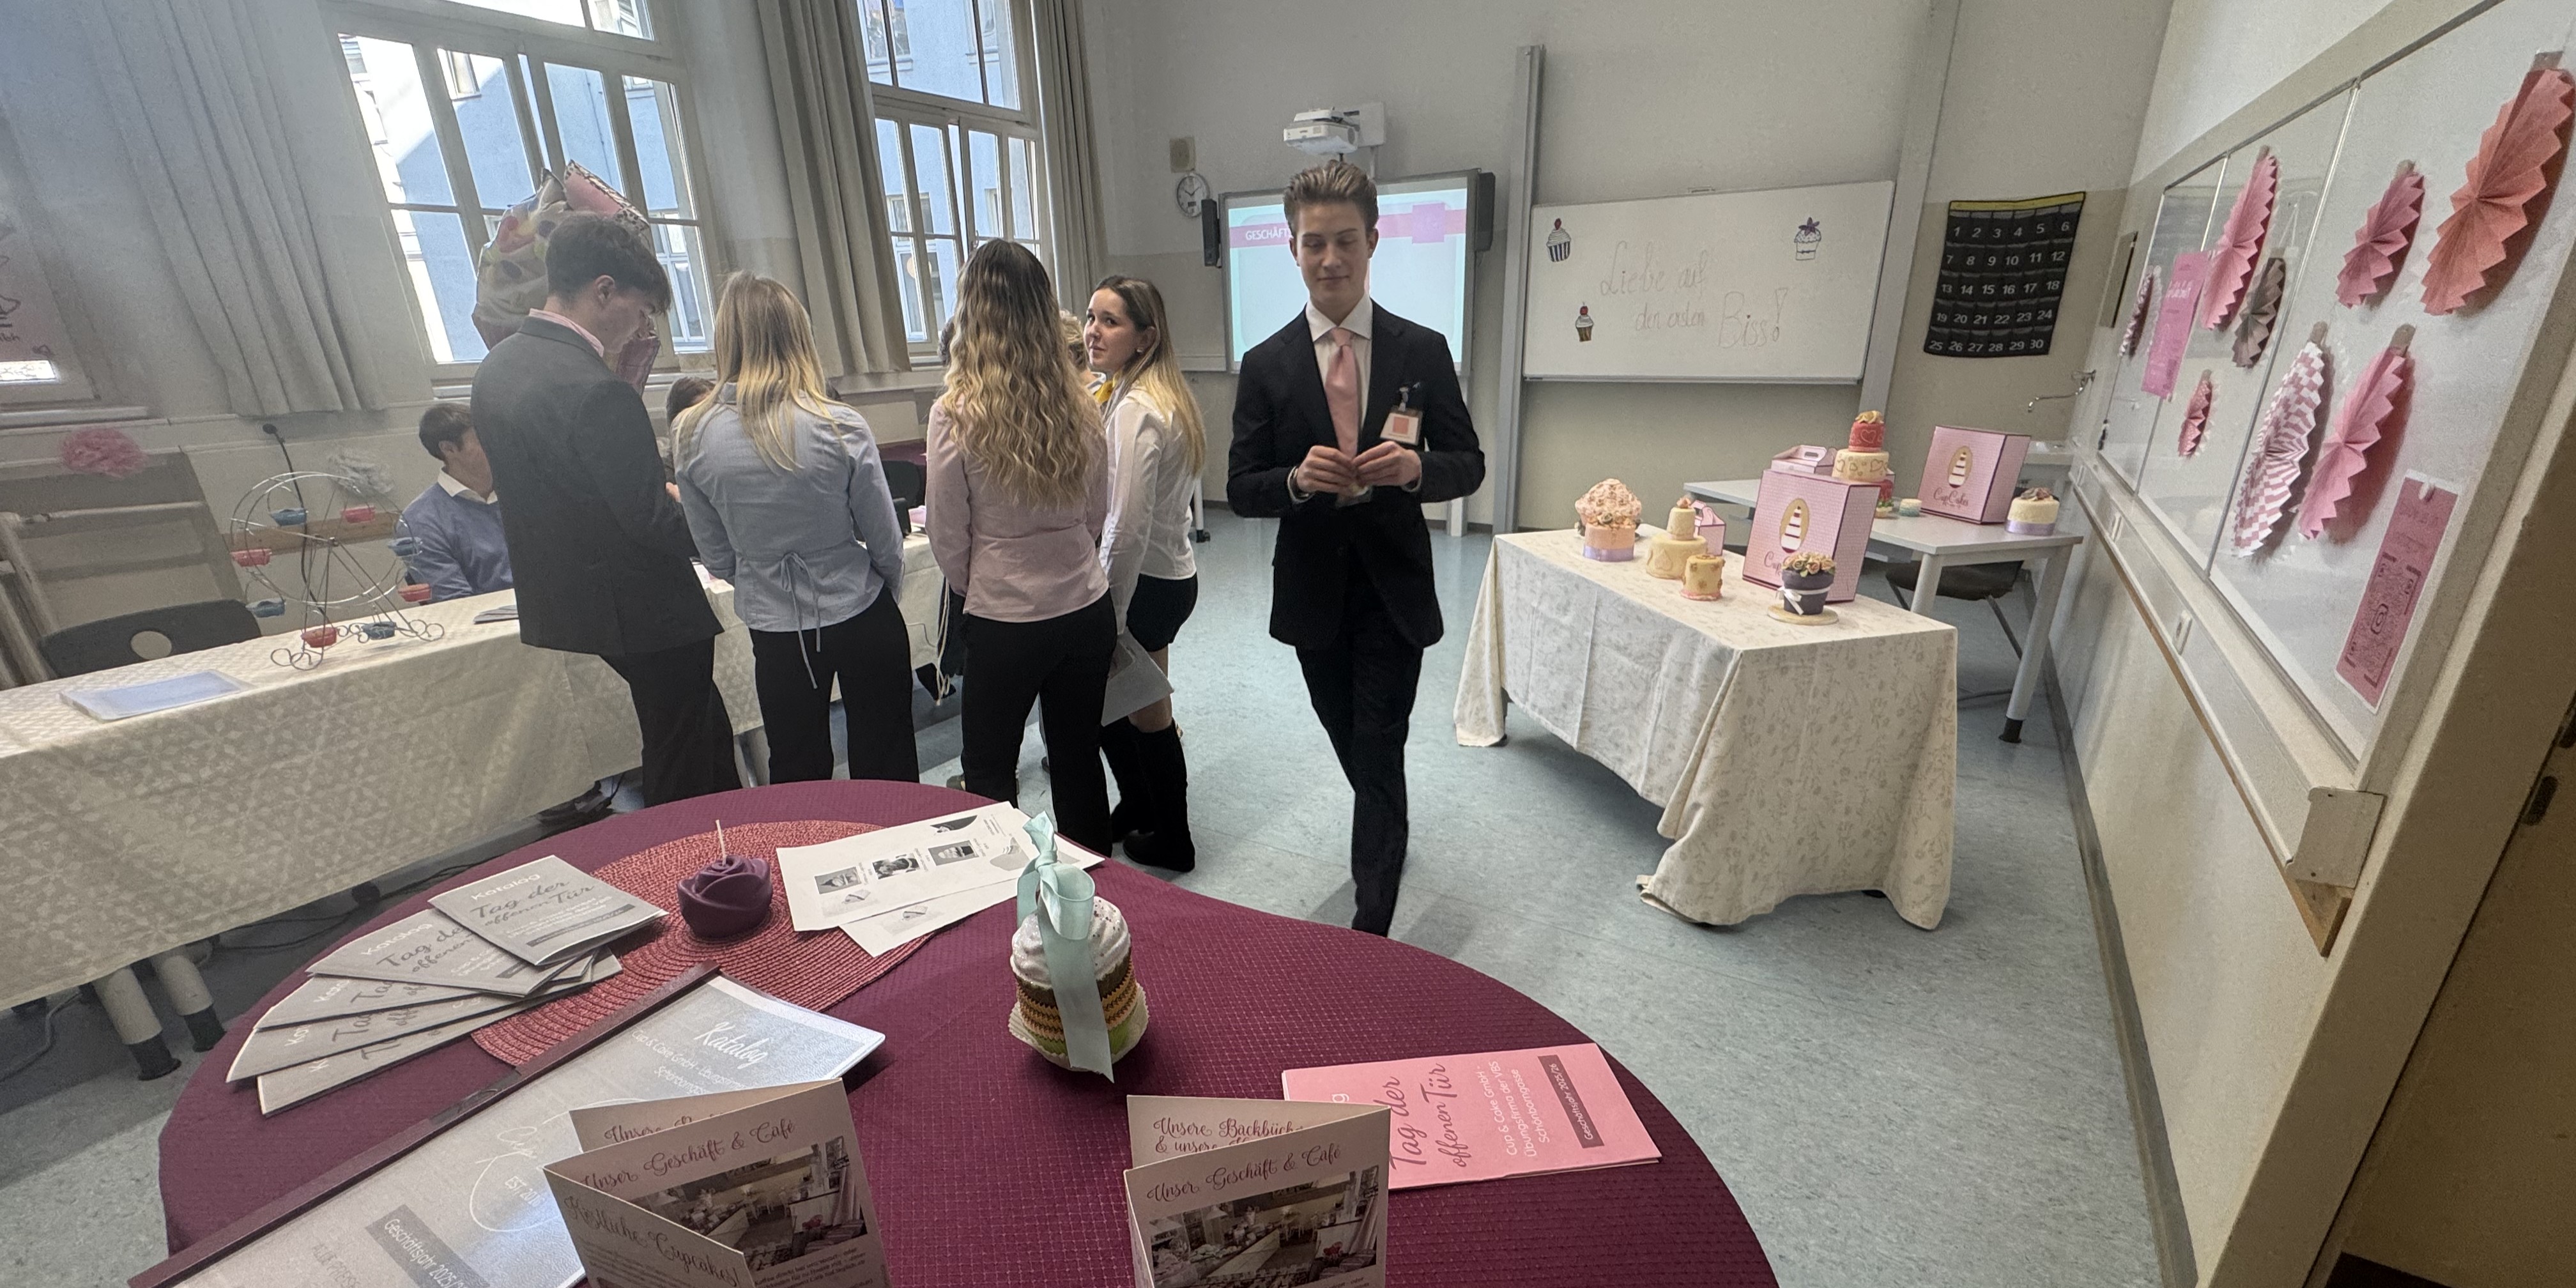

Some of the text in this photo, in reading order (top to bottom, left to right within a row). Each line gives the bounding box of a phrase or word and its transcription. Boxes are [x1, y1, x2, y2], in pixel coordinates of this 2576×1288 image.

[1953, 222, 2069, 238] 1 2 3 4 5 6
[1600, 240, 1708, 298] Liebe auf
[1946, 251, 2065, 266] 7 8 9 10 11 12
[1941, 280, 2060, 295] 13 14 15 16 17 18
[1937, 309, 2053, 325] 19 20 21 22 23 24
[1929, 339, 2044, 352] 25 26 27 28 29 30
[470, 897, 523, 919] Tag
[528, 881, 570, 900] der
[471, 873, 541, 901] Katalog
[484, 899, 551, 926] offenen
[548, 885, 595, 904] Tür
[361, 923, 433, 955] Katalog
[376, 943, 433, 967] Tag
[694, 1022, 769, 1070] Katalog
[1489, 1061, 1503, 1078] VBS
[1476, 1071, 1494, 1098] GmbH
[1498, 1078, 1510, 1094] der
[1420, 1063, 1471, 1167] offenen Tür
[1549, 1063, 1593, 1140] Geschäftsjahr 2025/26
[1154, 1117, 1212, 1138] Unsere
[1373, 1076, 1427, 1170] Tag der
[1498, 1124, 1509, 1133] &
[643, 1140, 726, 1176] Geschäft
[732, 1132, 744, 1150] &
[749, 1119, 795, 1144] Café
[1155, 1135, 1167, 1153] &
[1504, 1135, 1517, 1155] Cup
[1147, 1143, 1340, 1202] Unser Geschäft & Café
[385, 1218, 436, 1270] Geschäftsjahr
